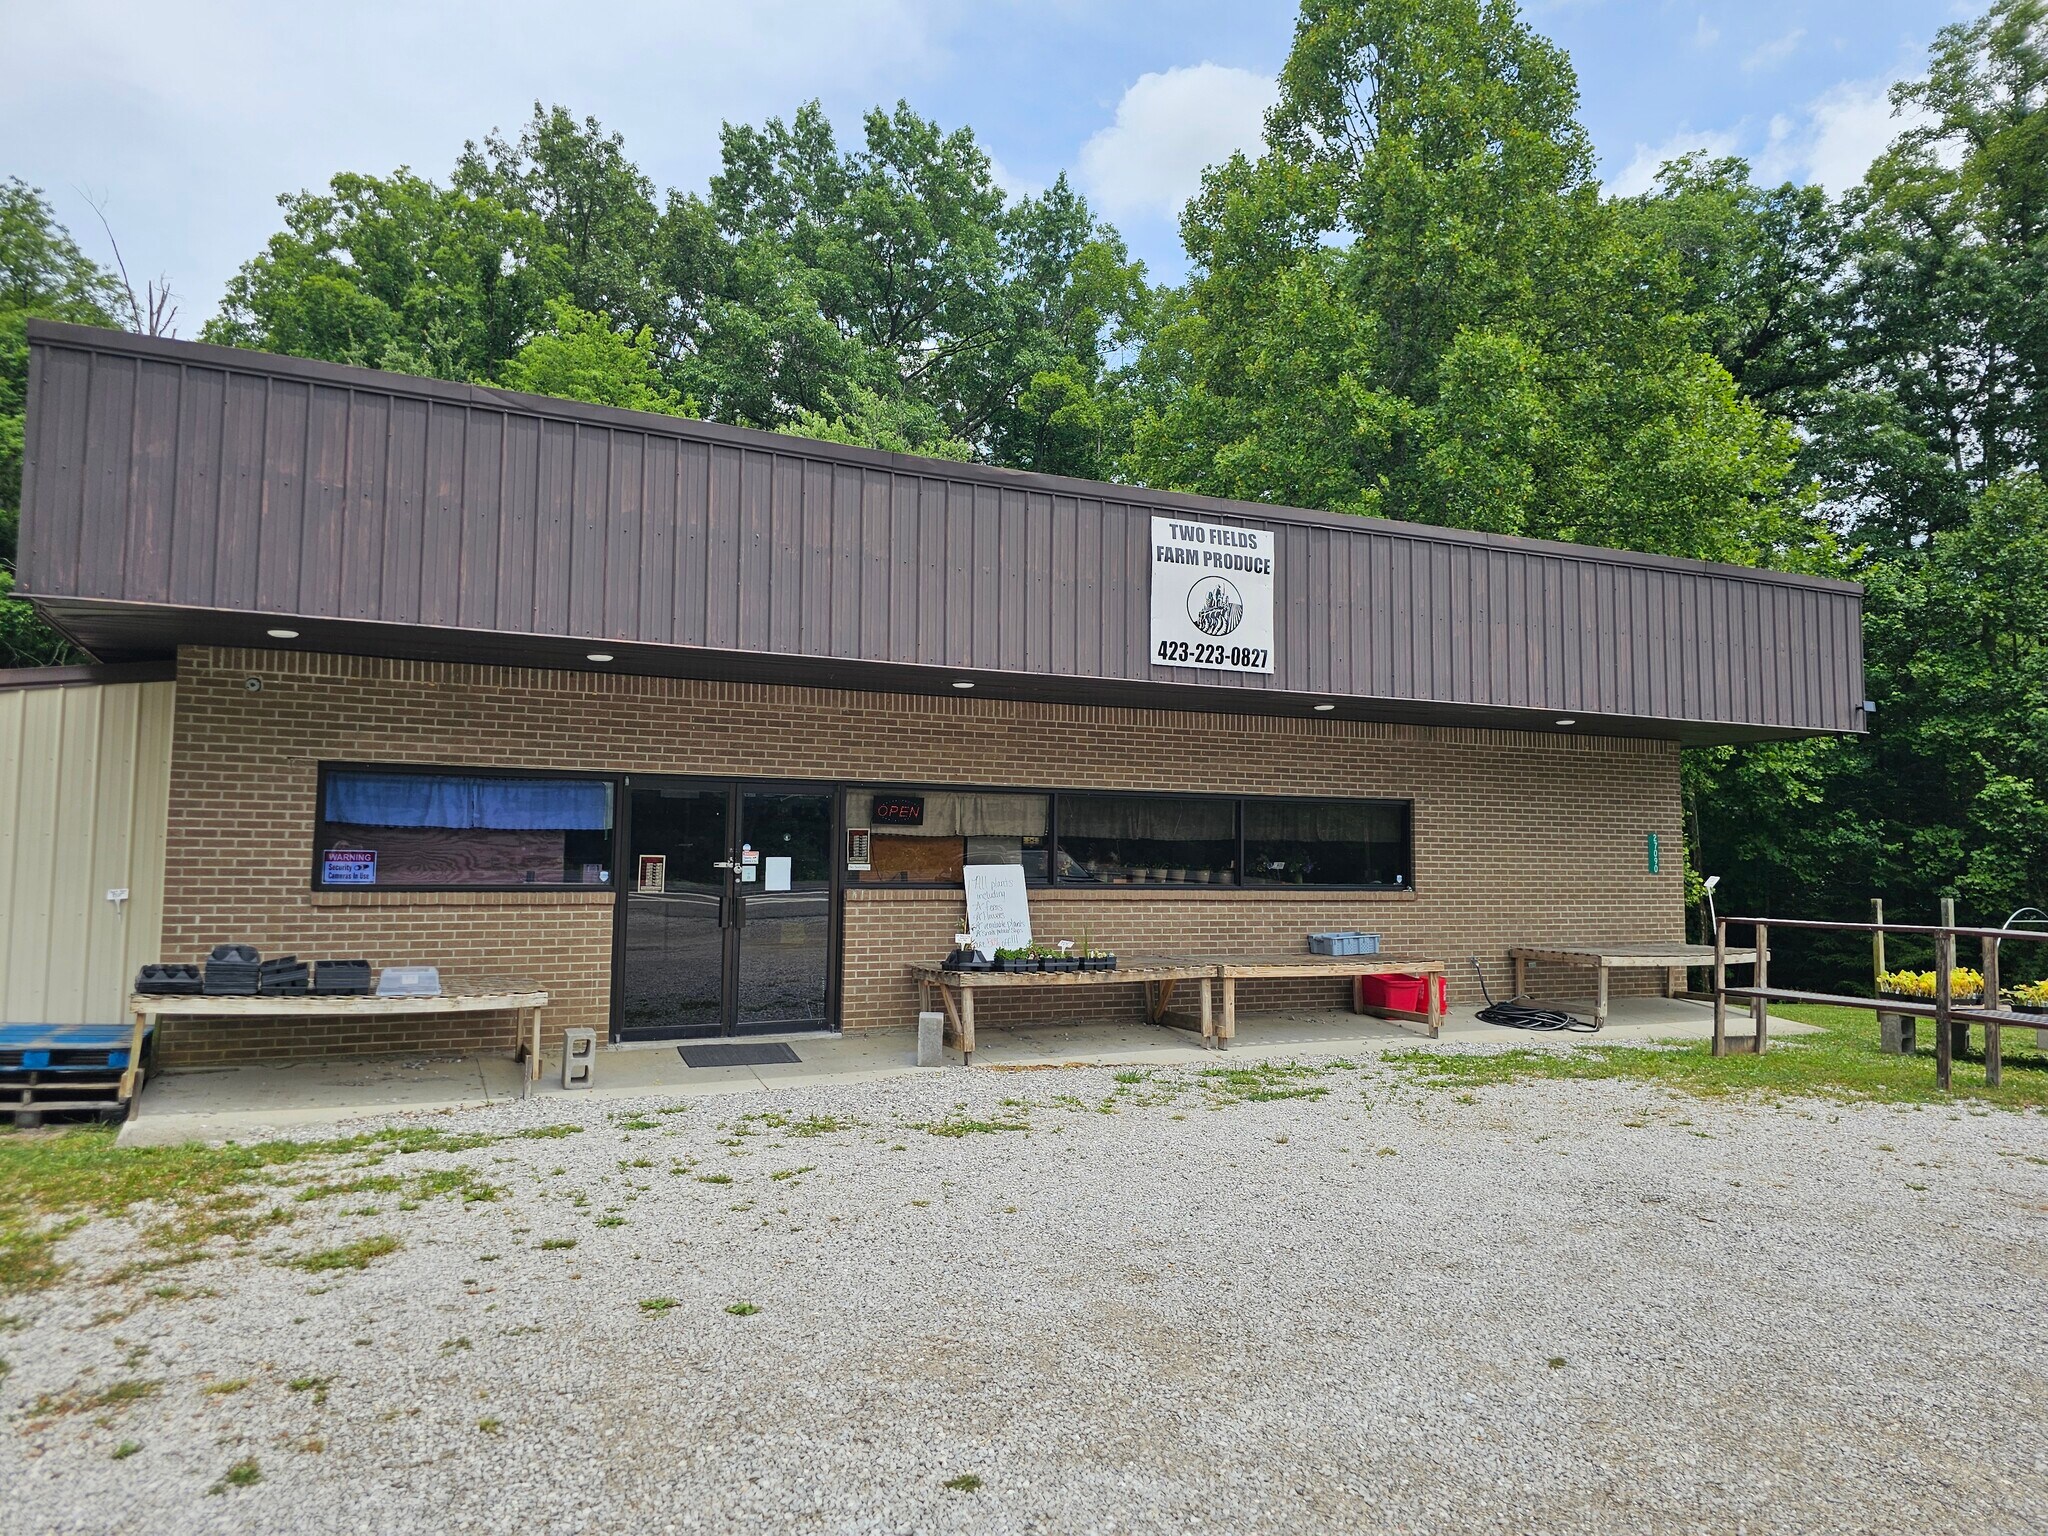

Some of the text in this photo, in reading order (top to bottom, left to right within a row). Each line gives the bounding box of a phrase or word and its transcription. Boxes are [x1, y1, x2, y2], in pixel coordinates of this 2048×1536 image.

[1169, 524, 1258, 549] TWO FIELDS
[1156, 545, 1270, 575] FARM PRODUCE
[1158, 640, 1268, 668] 423-223-0827
[877, 805, 920, 818] OPEN
[328, 853, 372, 861] WARNING
[328, 863, 352, 872] Security
[972, 875, 1014, 891] All plants
[976, 890, 1006, 900] including
